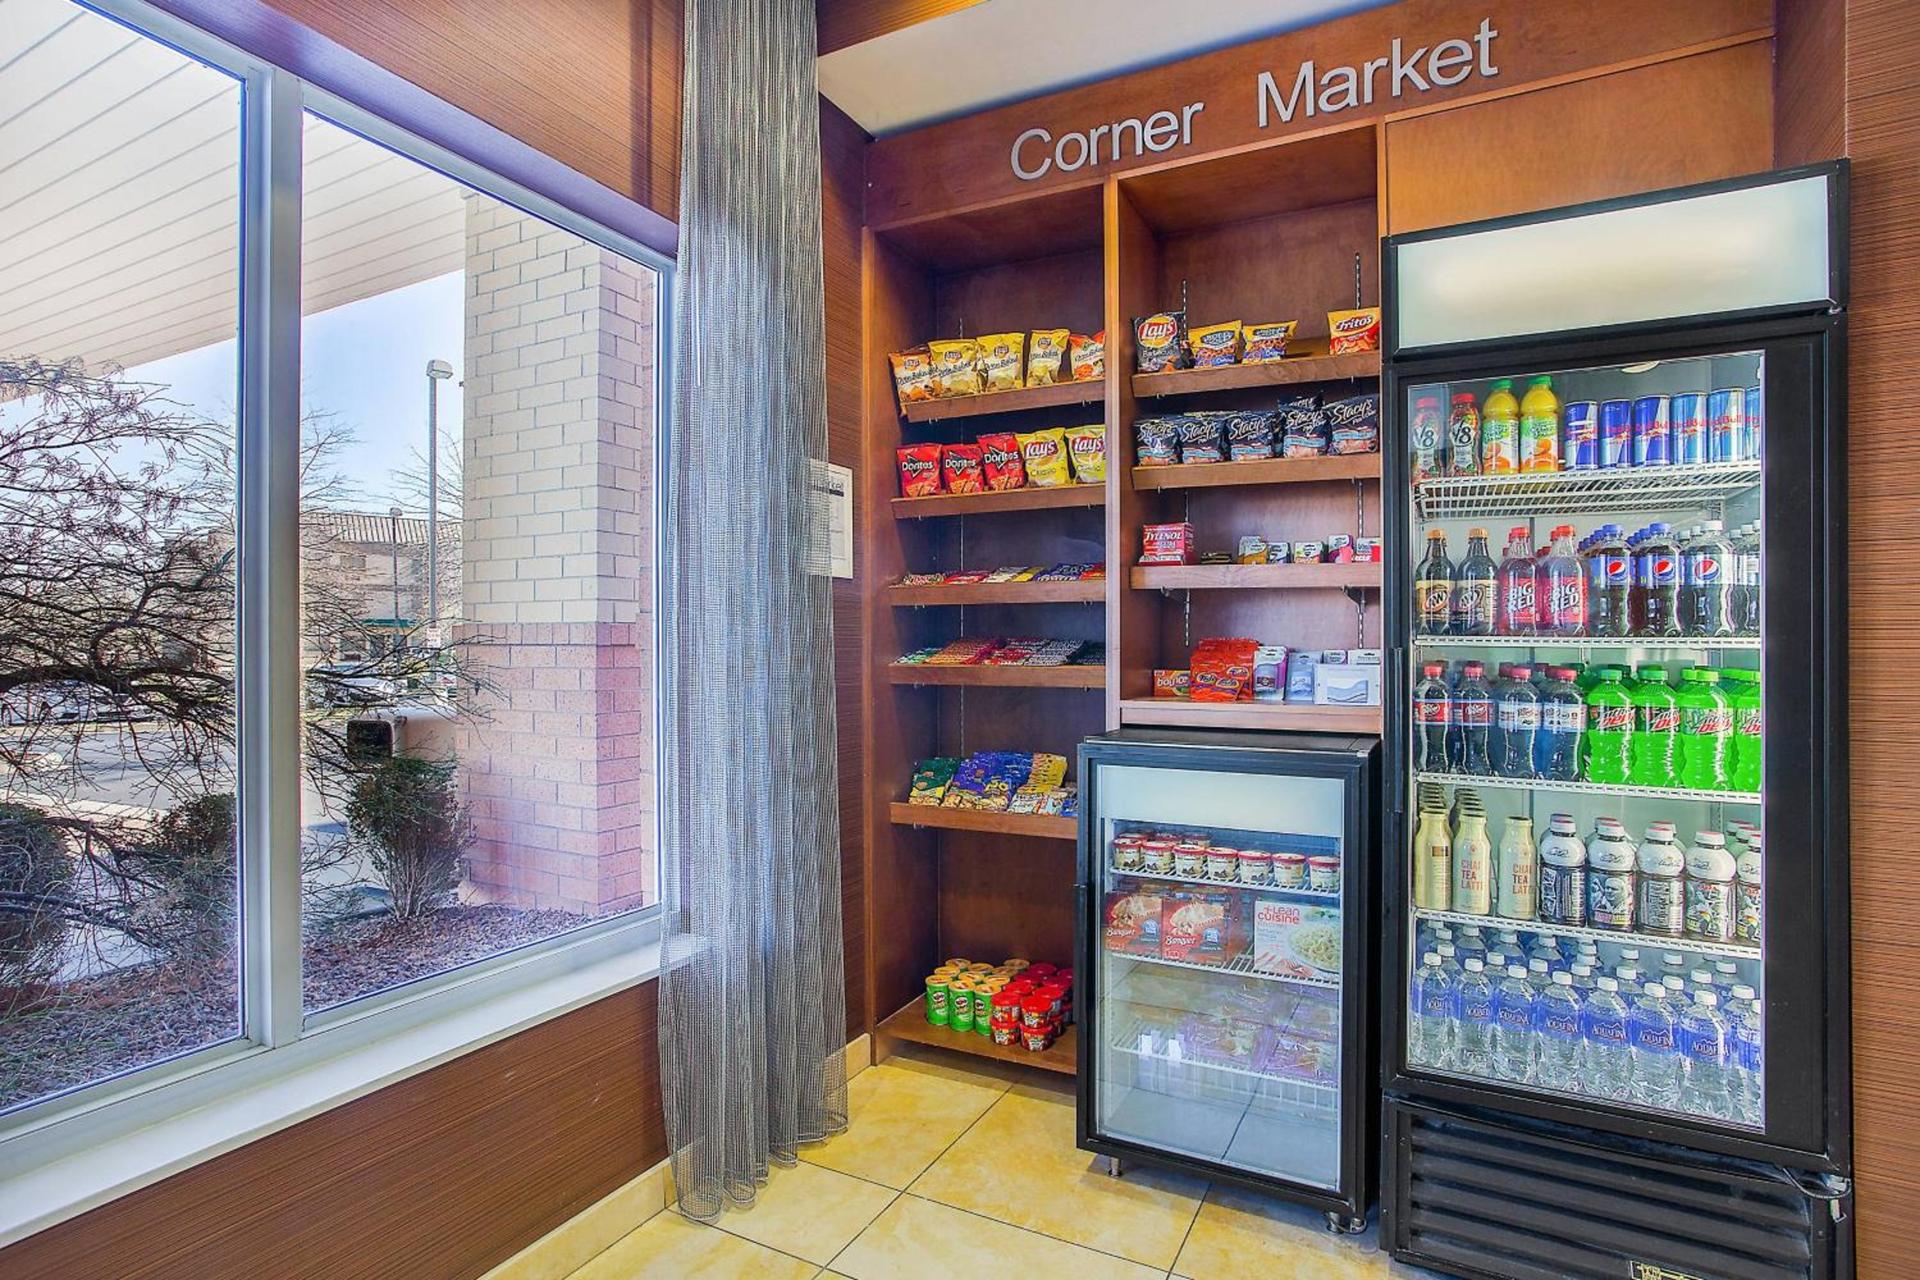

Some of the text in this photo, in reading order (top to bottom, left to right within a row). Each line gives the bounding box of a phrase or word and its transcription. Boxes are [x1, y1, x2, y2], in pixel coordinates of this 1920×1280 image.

[1010, 17, 1499, 181] Corner Market
[1338, 316, 1373, 331] Fritos
[1331, 399, 1373, 425] Stacy's
[1229, 418, 1266, 441] Stacy's
[1413, 426, 1434, 448] V8
[1451, 420, 1472, 445] V8
[945, 459, 977, 468] Doritos
[984, 452, 1019, 463] Doritos
[902, 461, 934, 471] Doritos
[1145, 531, 1183, 540] TYLENOL
[1510, 582, 1533, 600] BIG
[1552, 582, 1578, 600] BIG
[1508, 594, 1535, 613] RED
[1462, 870, 1476, 879] TEA
[1512, 874, 1528, 884] TEA
[1165, 936, 1196, 945] Banquet
